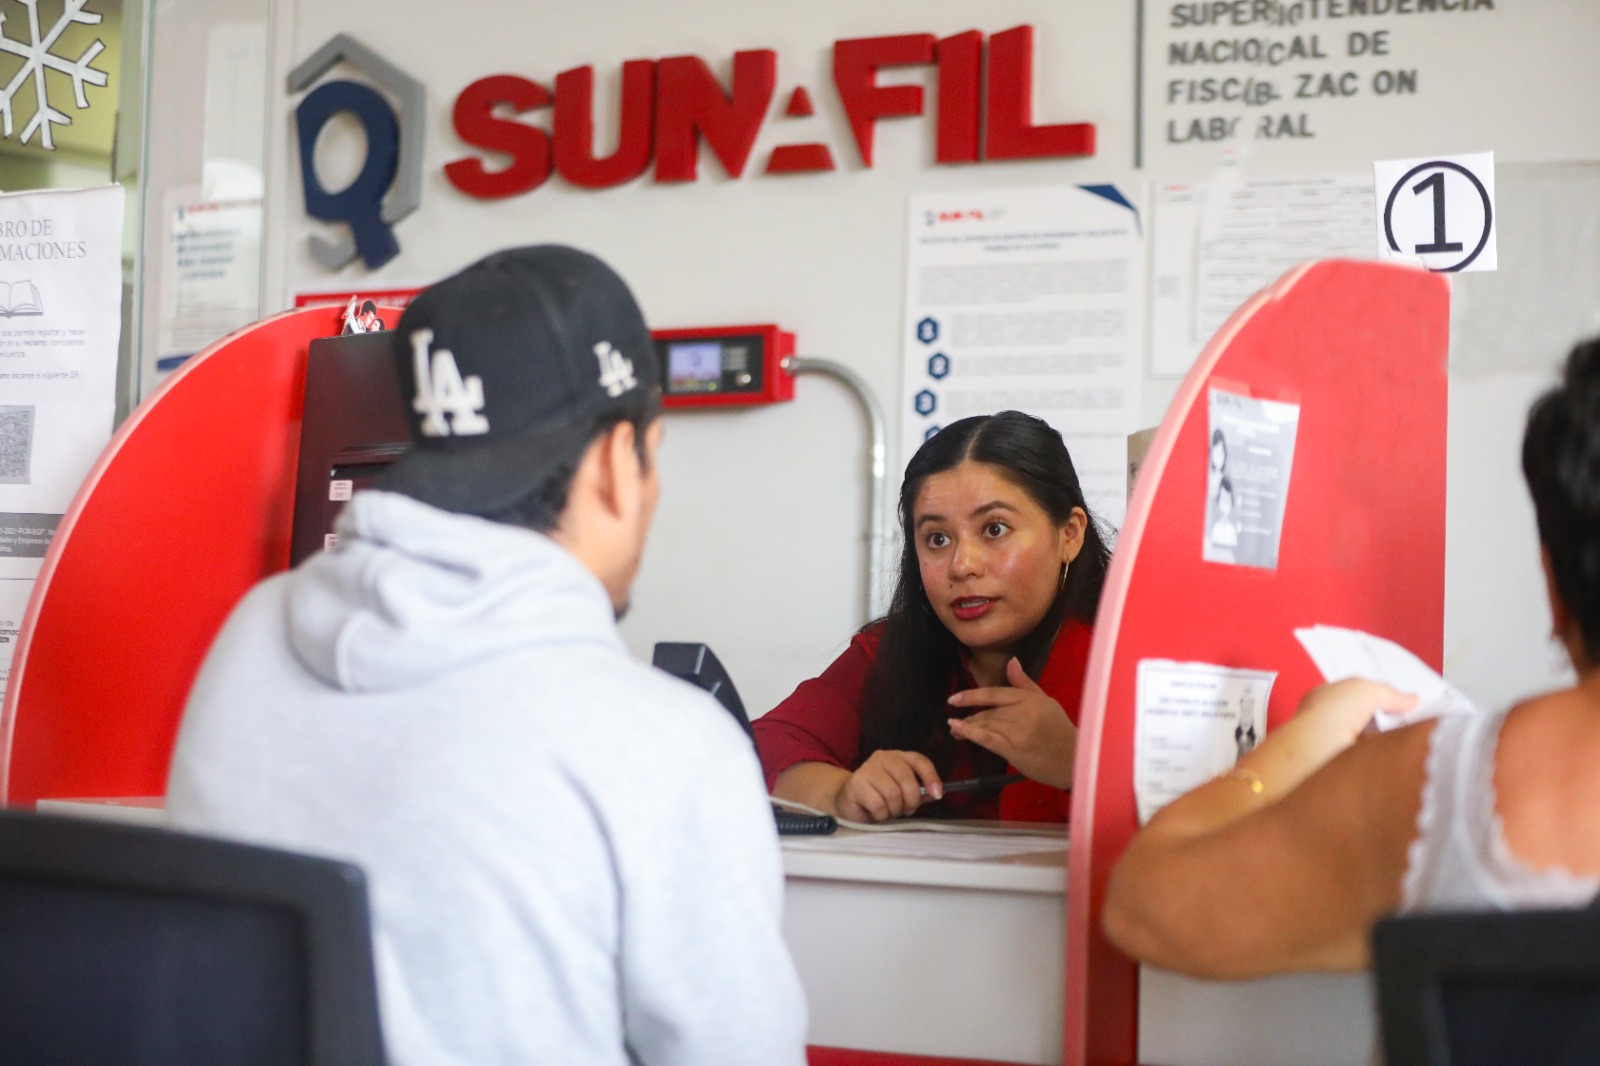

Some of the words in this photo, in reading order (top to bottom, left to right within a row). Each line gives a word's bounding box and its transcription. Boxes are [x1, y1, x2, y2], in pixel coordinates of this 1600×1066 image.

[1348, 30, 1390, 57] DE
[443, 24, 1096, 200] SUNAFIL
[31, 219, 53, 237] DE
[1412, 172, 1463, 254] 1
[0, 240, 87, 261] MACIONES
[409, 327, 490, 436] LA
[593, 340, 637, 397] LA
